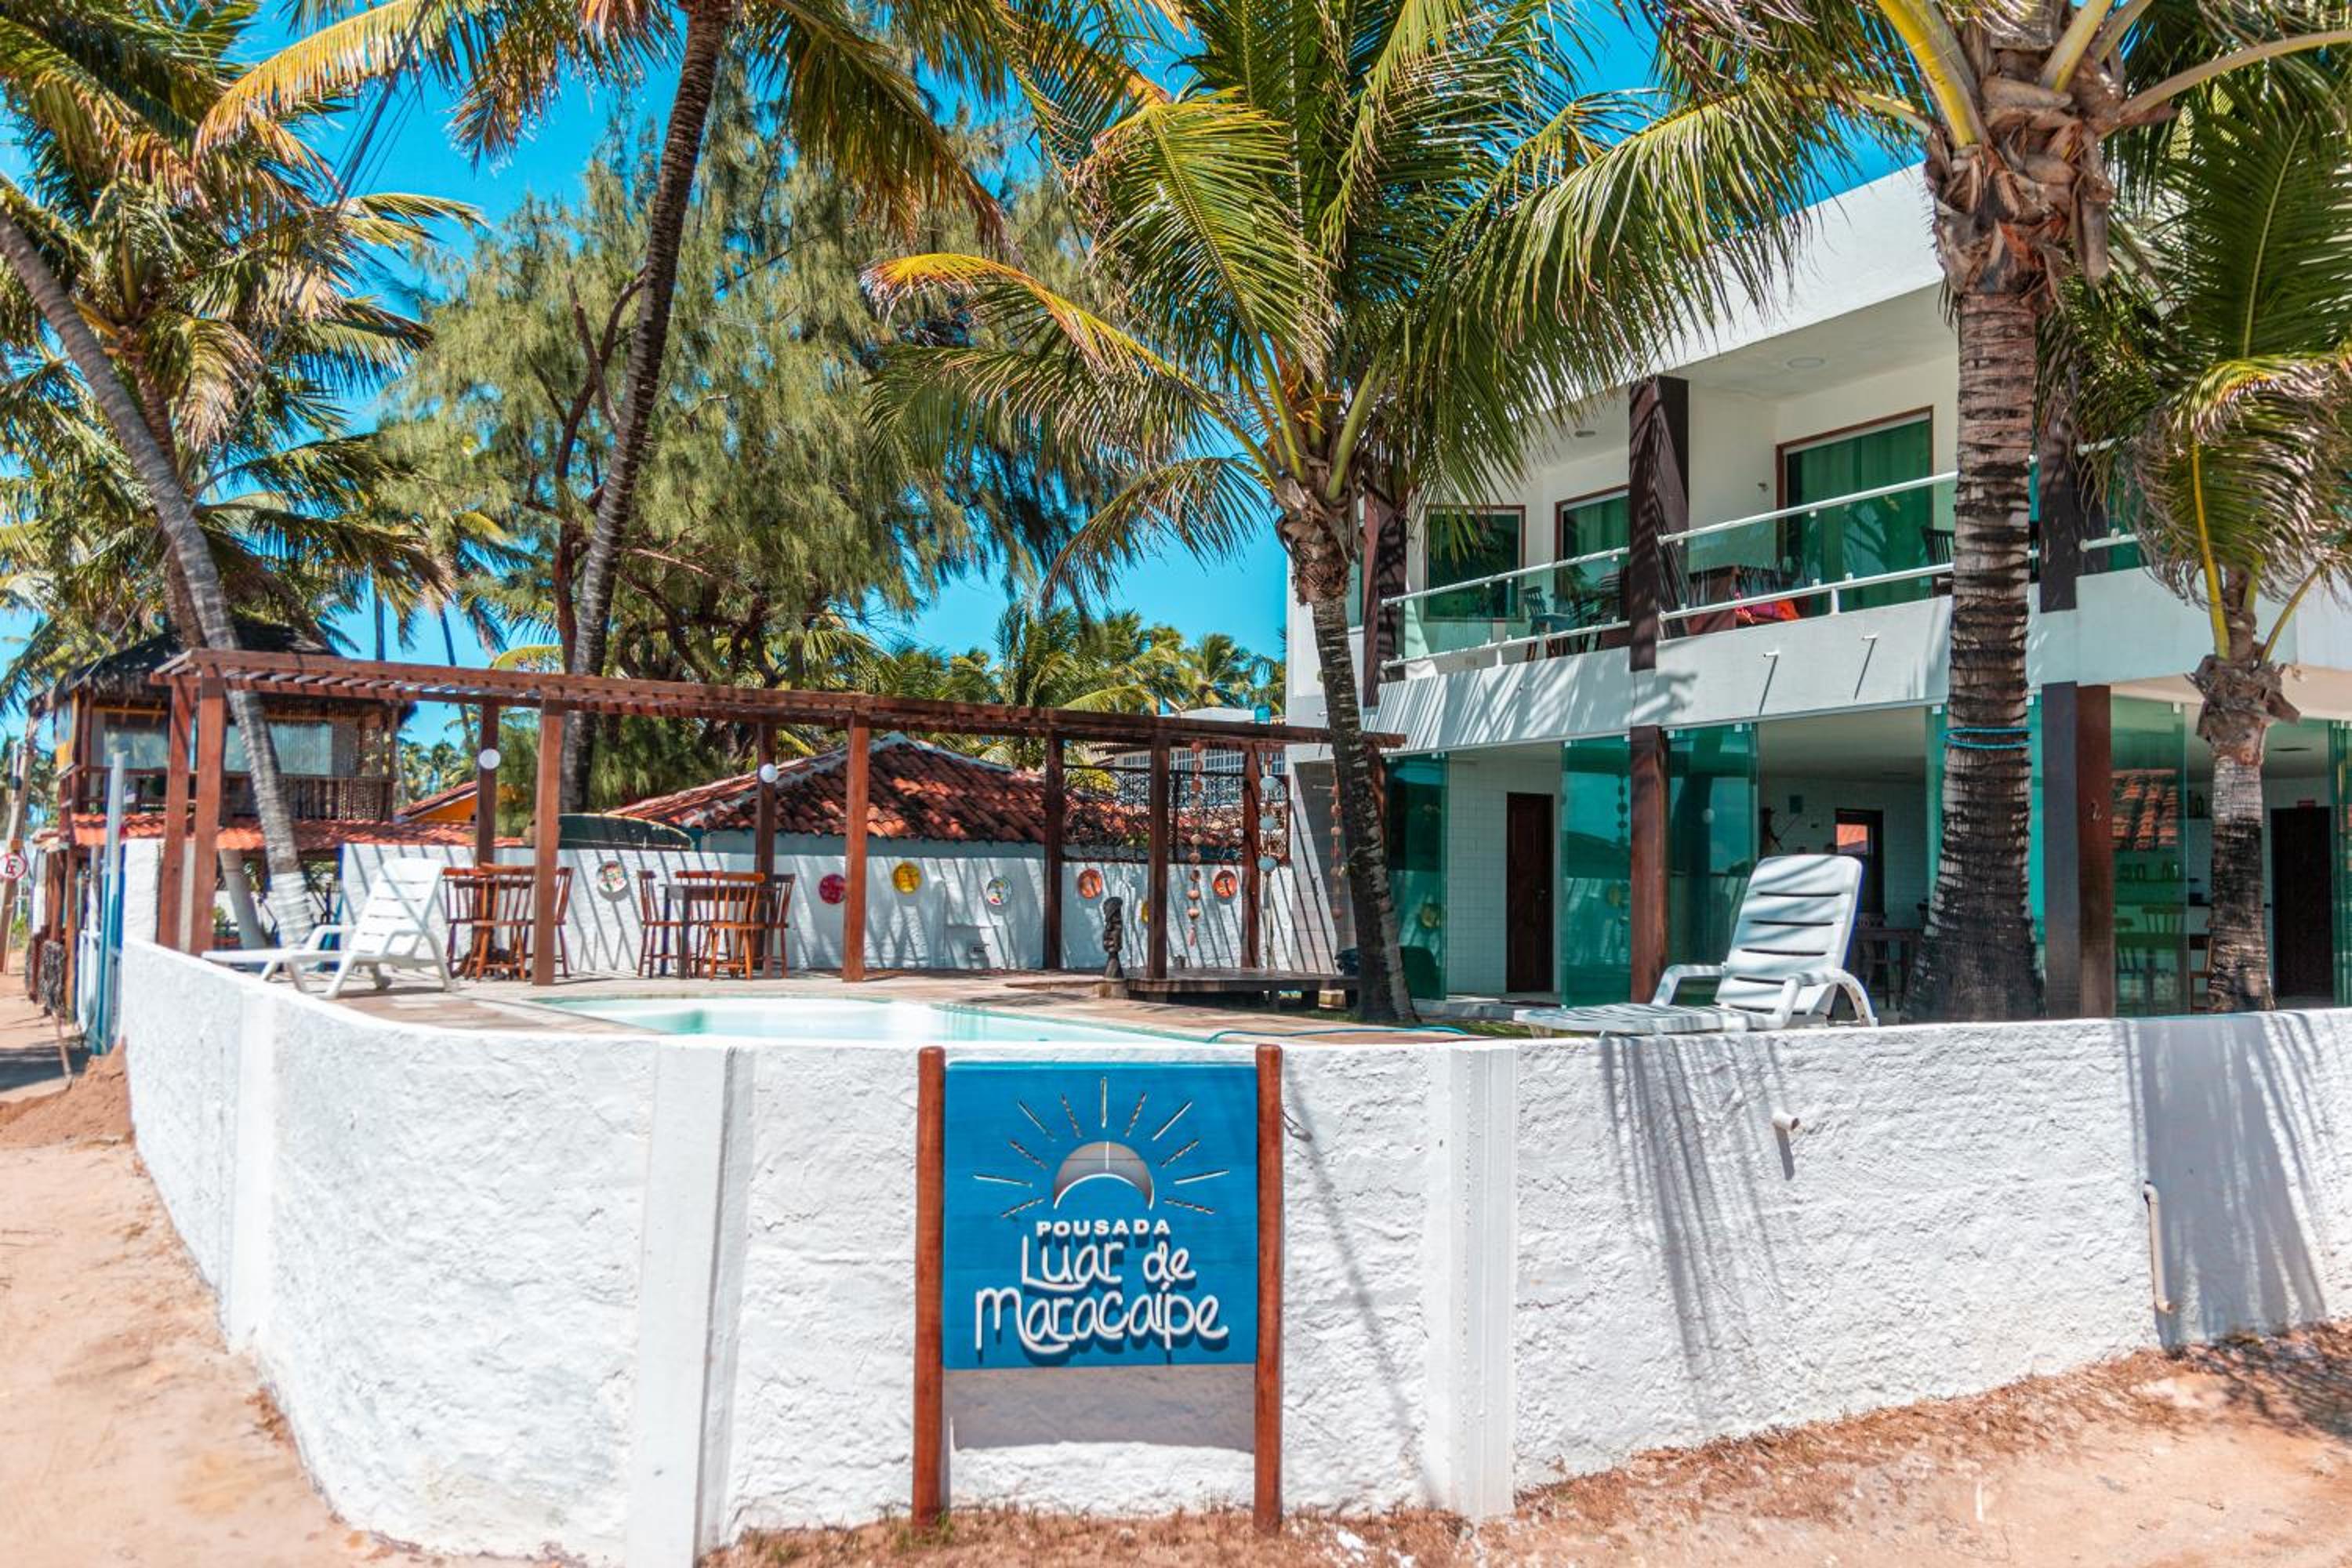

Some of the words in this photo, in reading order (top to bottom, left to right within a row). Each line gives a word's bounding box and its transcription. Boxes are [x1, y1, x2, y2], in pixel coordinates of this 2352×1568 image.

[1035, 1219, 1171, 1237] POUSADA
[1021, 1236, 1124, 1291] Luar
[1142, 1241, 1196, 1283] de
